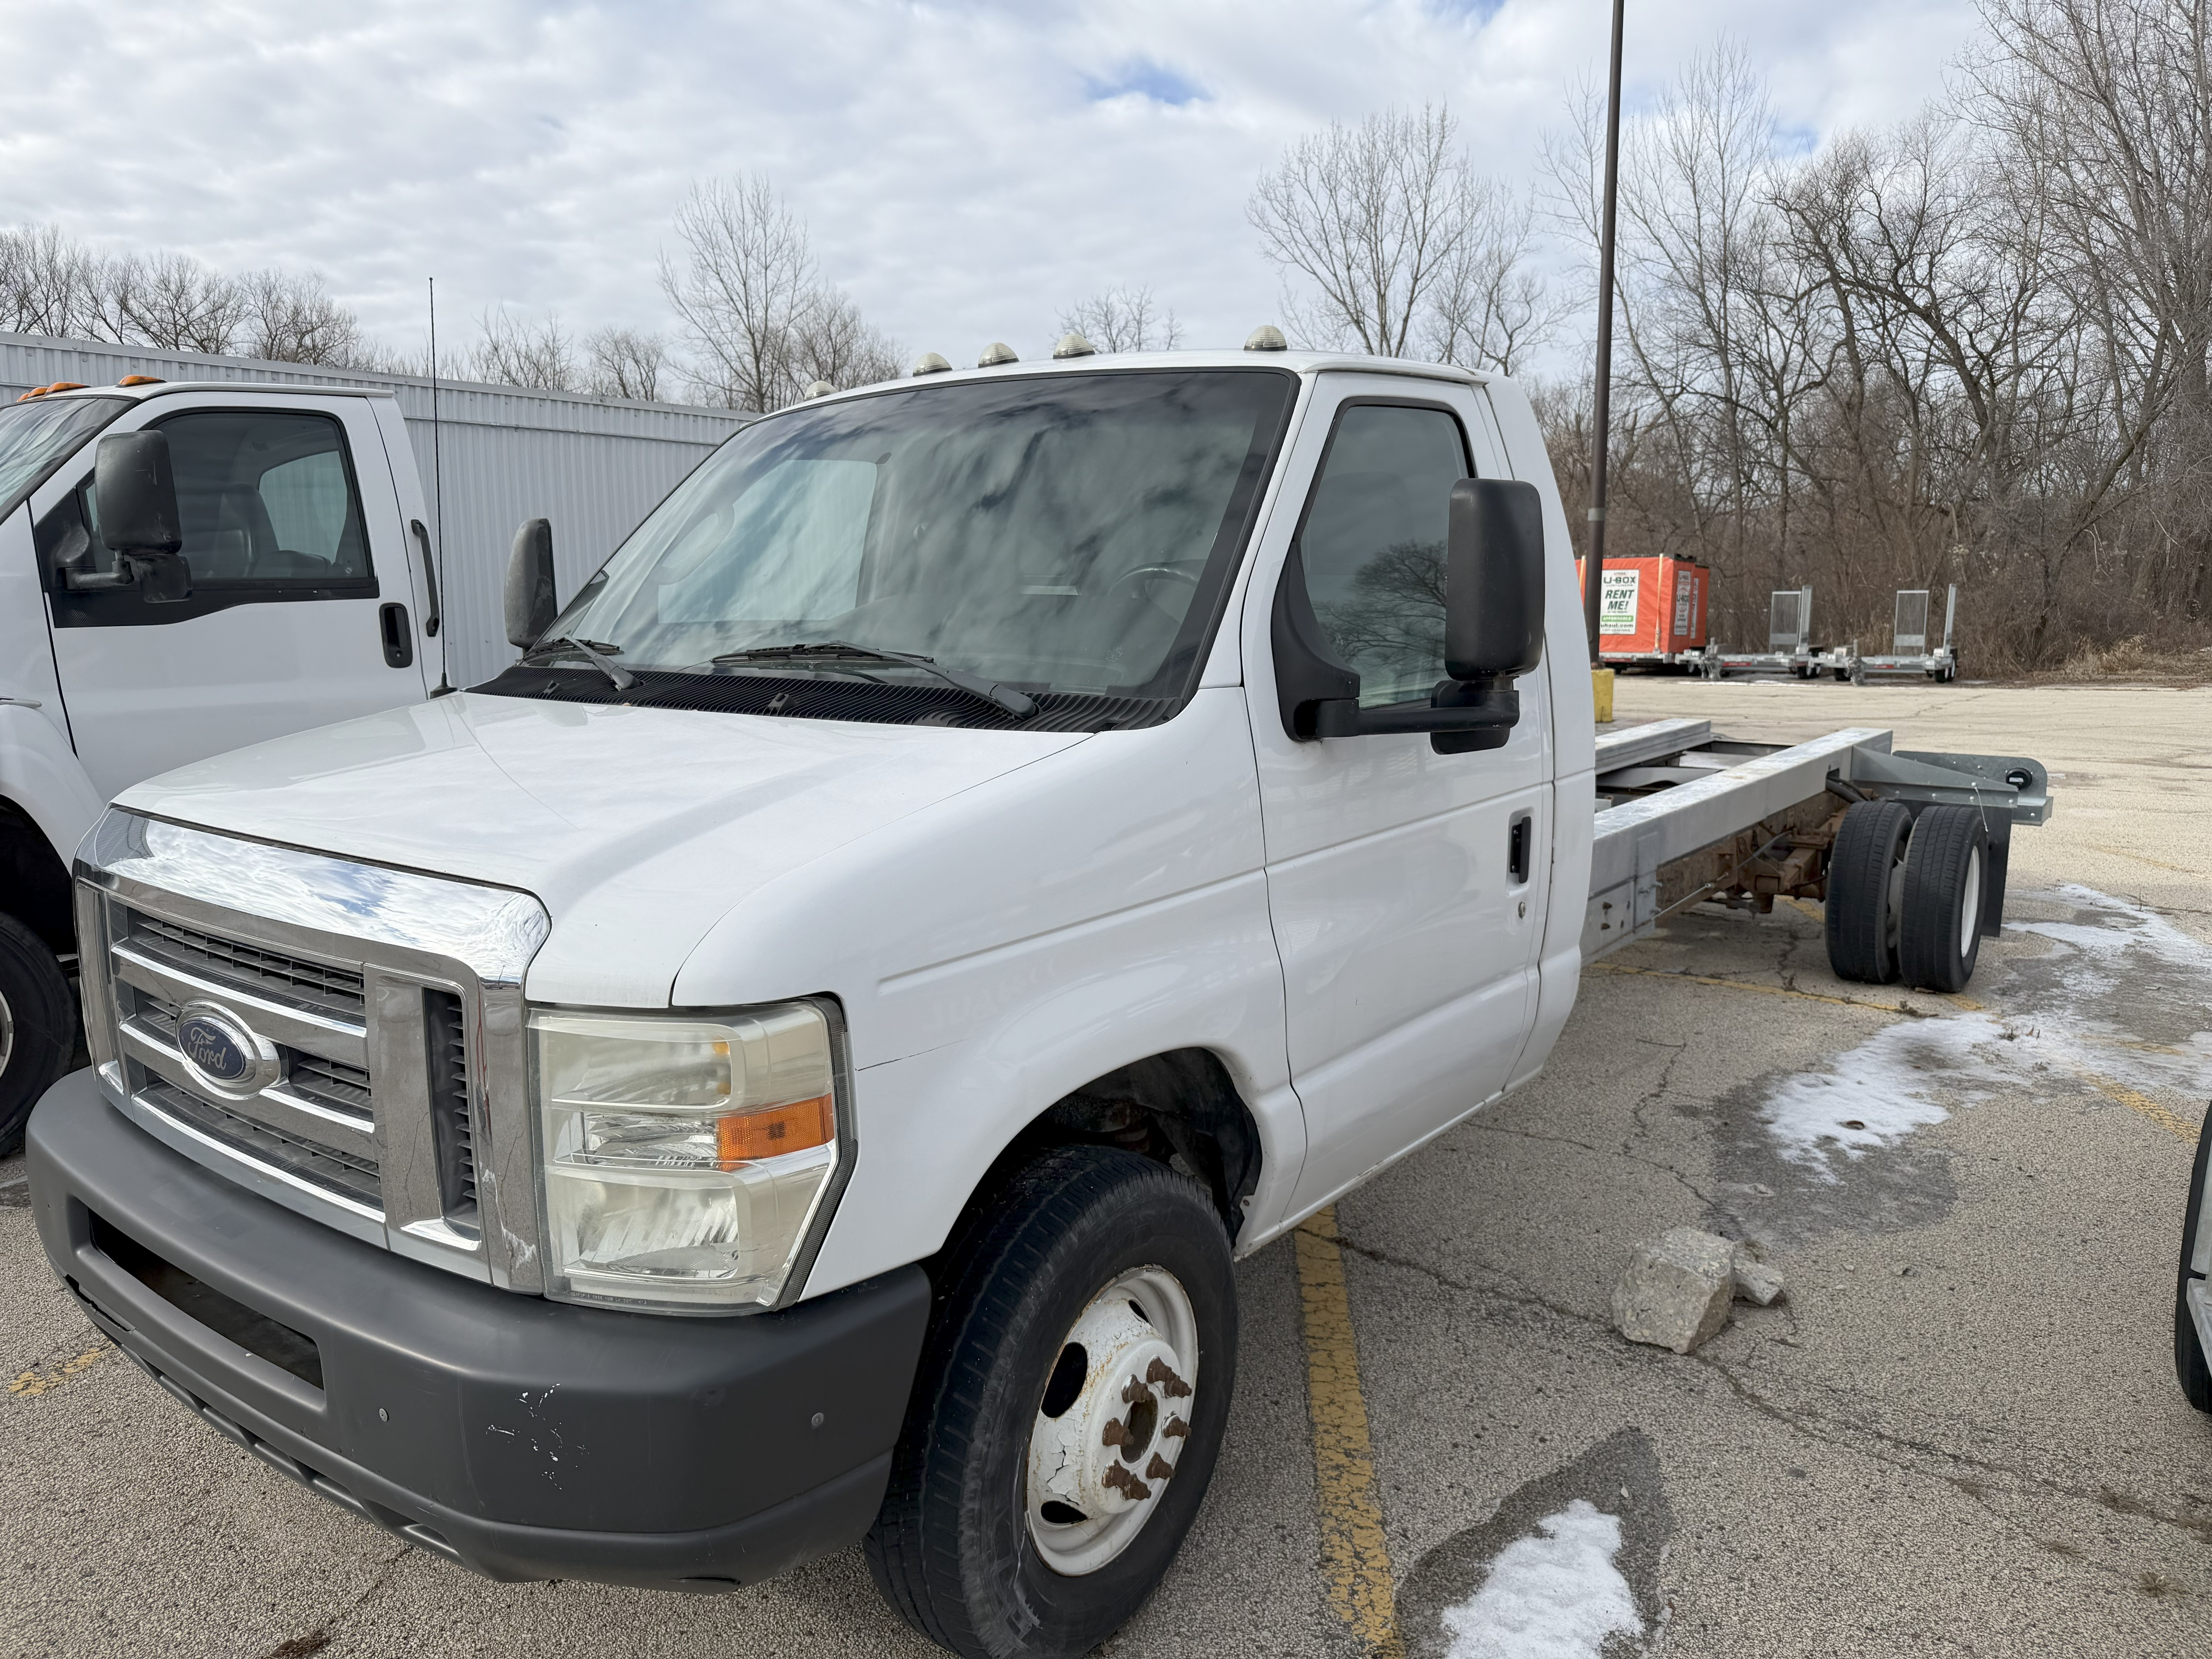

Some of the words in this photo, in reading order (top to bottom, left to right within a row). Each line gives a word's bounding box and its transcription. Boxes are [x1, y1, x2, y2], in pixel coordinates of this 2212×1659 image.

[1605, 589, 1635, 599] RENT
[1607, 601, 1629, 610] ME!
[188, 1027, 227, 1070] Ford
